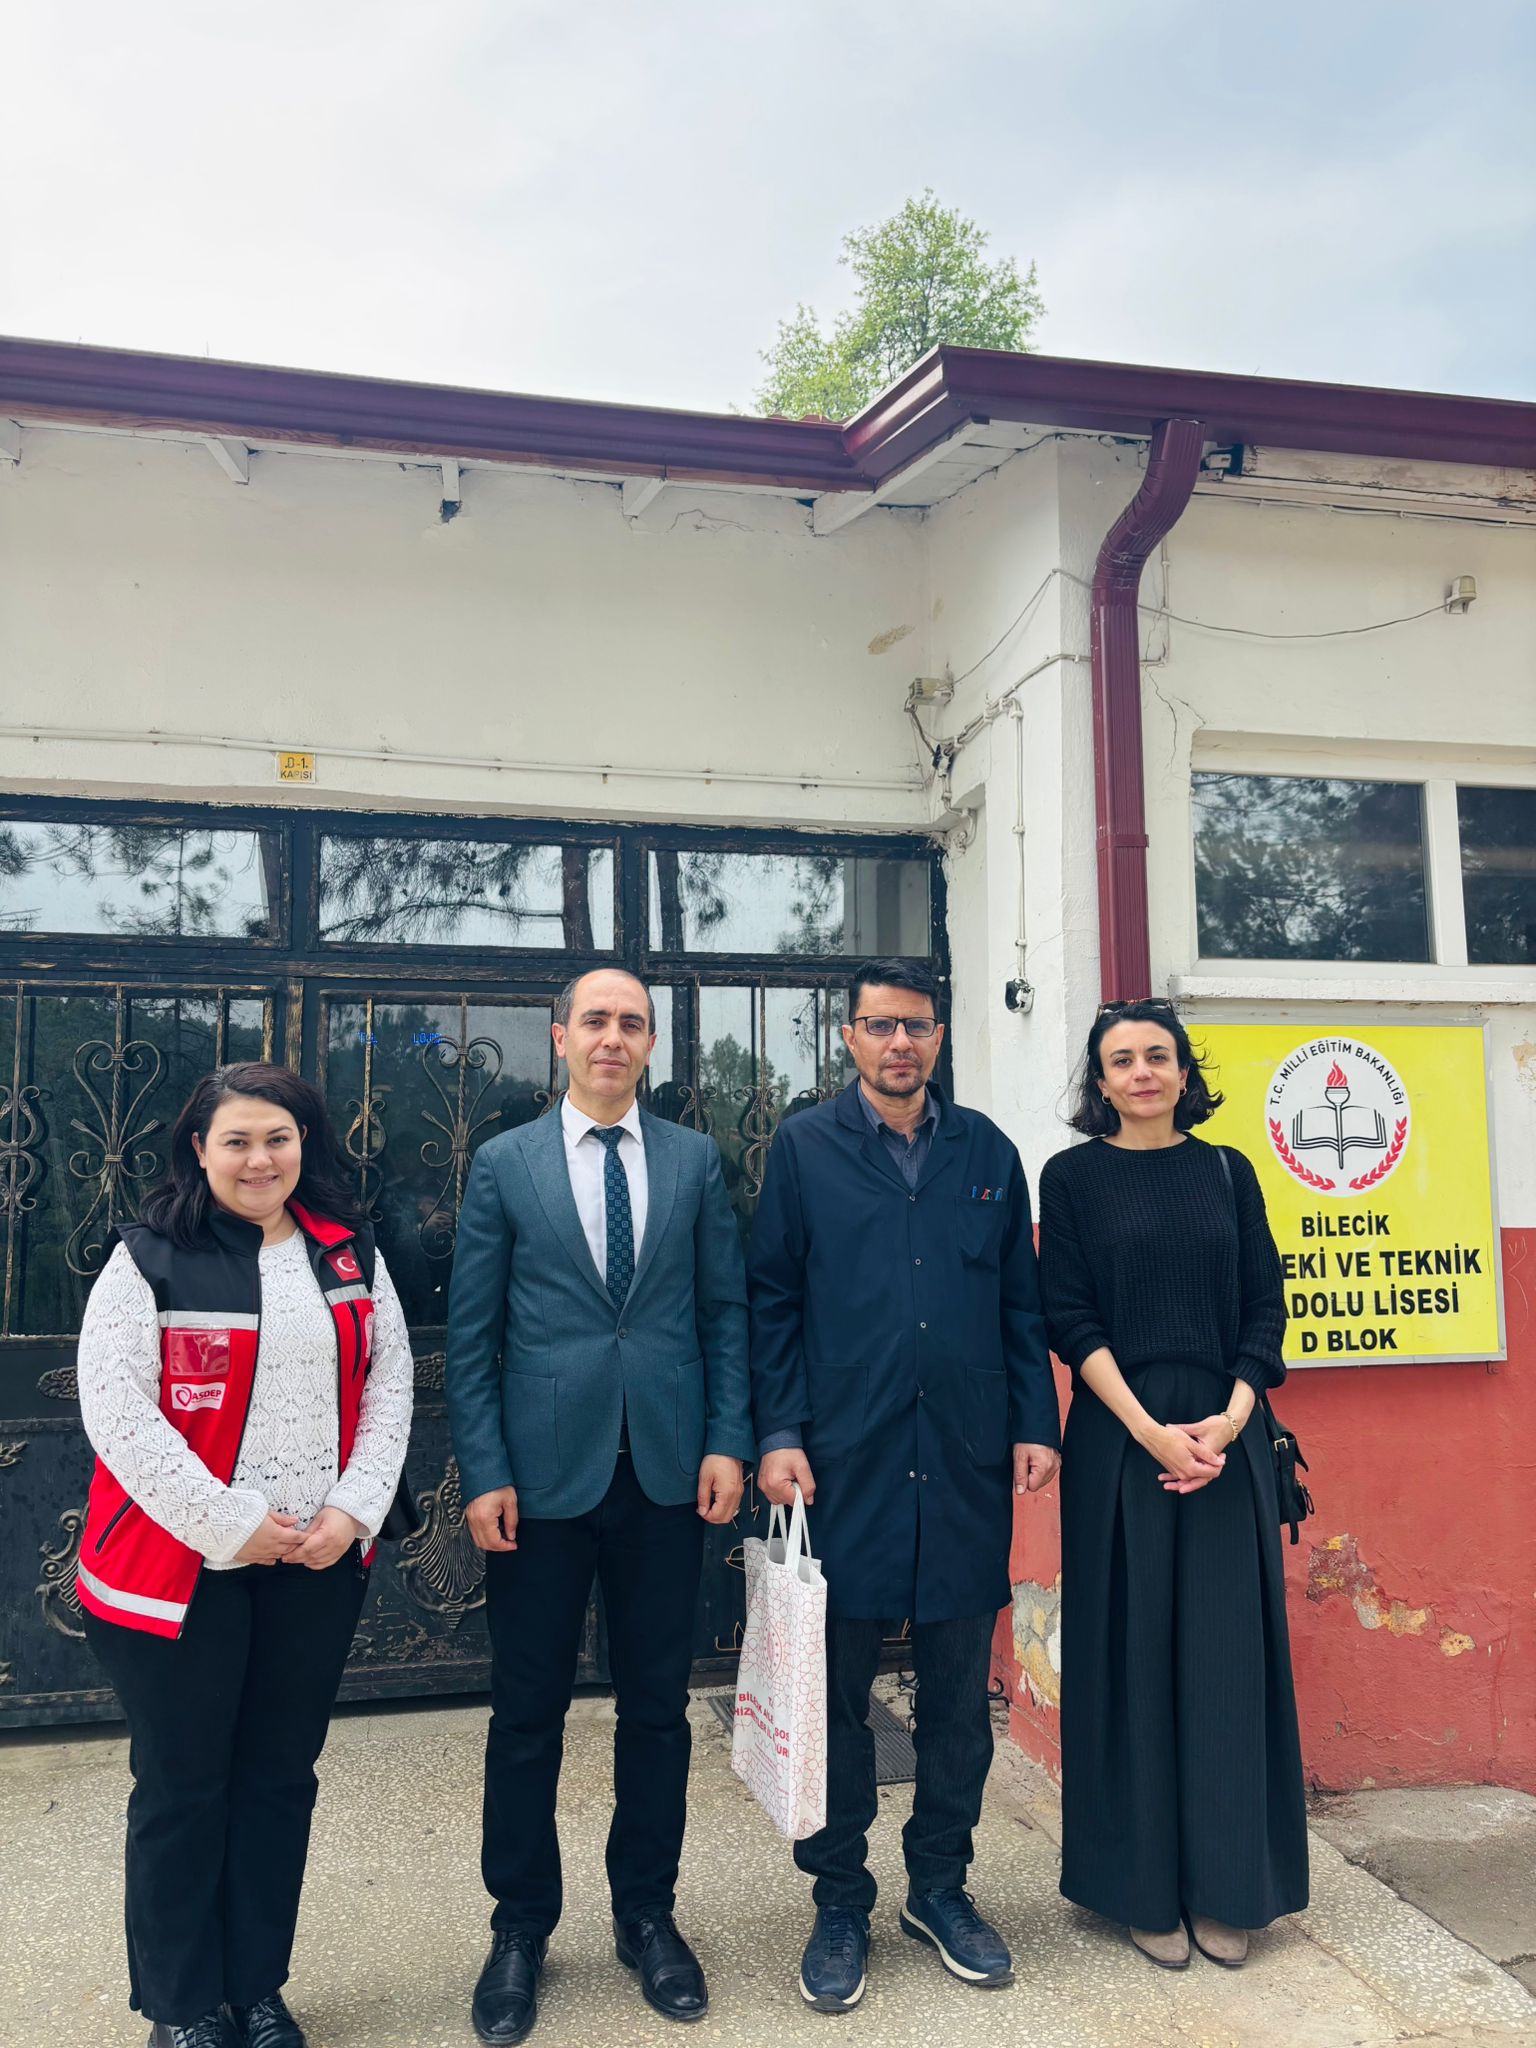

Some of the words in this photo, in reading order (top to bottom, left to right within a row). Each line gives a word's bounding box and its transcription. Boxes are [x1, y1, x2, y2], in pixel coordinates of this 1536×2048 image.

[1270, 1083, 1286, 1105] T.C.
[1280, 1048, 1309, 1080] MİLLİ
[1310, 1039, 1352, 1057] EĞİTİM
[1355, 1047, 1405, 1105] BAKANLIĞI
[1301, 1210, 1391, 1238] BİLECİK
[1283, 1246, 1327, 1280] EKİ
[1335, 1252, 1371, 1278] VE
[1379, 1243, 1482, 1277] TEKNİK
[1374, 1282, 1459, 1315] LİSESİ
[1301, 1331, 1318, 1353] D
[1327, 1328, 1398, 1351] BLOK
[192, 1389, 222, 1400] ASDEP
